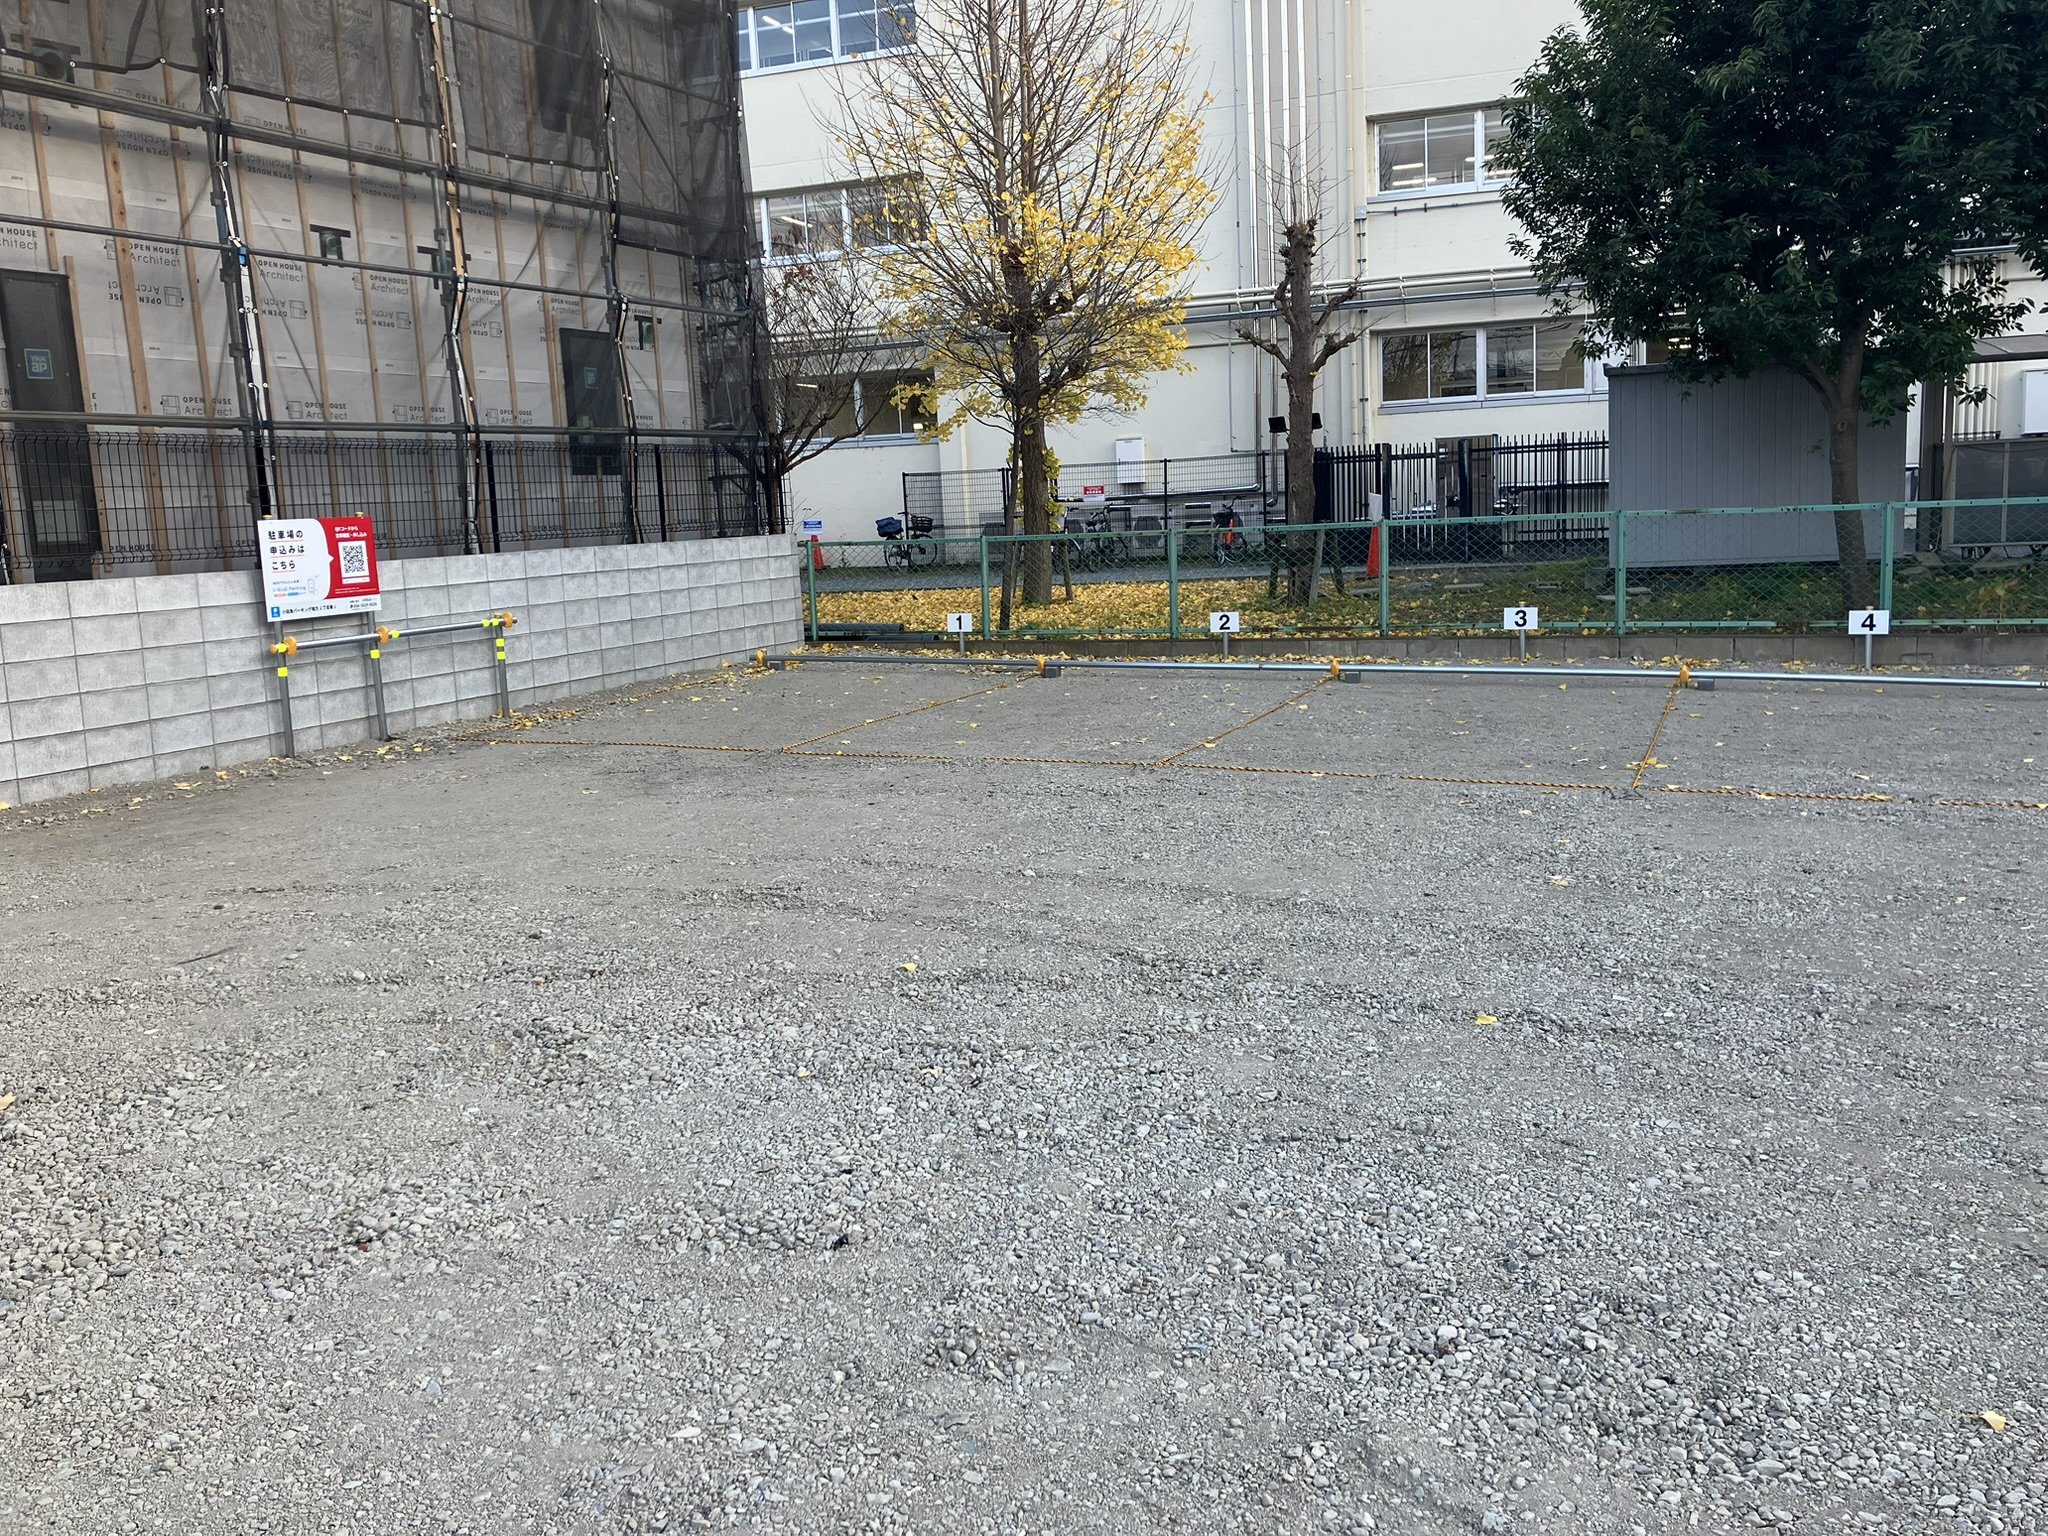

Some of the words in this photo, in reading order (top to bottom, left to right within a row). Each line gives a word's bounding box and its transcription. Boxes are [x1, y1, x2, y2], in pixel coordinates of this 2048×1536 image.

[117, 141, 144, 152] HOUSE
[146, 148, 169, 157] OPEN
[247, 166, 272, 176] HOUSE
[273, 171, 293, 180] OPEN
[383, 191, 400, 200] OPEN
[7, 227, 37, 238] HOUSE
[152, 244, 179, 255] HOUSE
[130, 253, 181, 267] Architect
[258, 260, 278, 269] OPEN
[279, 262, 303, 272] HOUSE
[259, 270, 305, 282] Architect
[369, 275, 386, 283] OPEN
[388, 277, 408, 286] HOUSE
[370, 283, 409, 296] Architect
[481, 289, 499, 297] HOUSE
[138, 296, 162, 305] OPEN
[550, 297, 564, 305] OPEN
[268, 309, 288, 317] OPEN
[377, 320, 396, 328] OPEN
[473, 329, 488, 337] OPEN
[30, 354, 47, 363] YKK
[32, 362, 48, 373] ap
[182, 396, 205, 404] OPEN
[268, 529, 304, 540] 駐車場の
[269, 545, 305, 555] 申込みは
[271, 559, 296, 570] こちら
[956, 614, 962, 630] 1
[1218, 613, 1231, 630] 2
[1514, 609, 1527, 628] 3
[1860, 613, 1877, 632] 4
